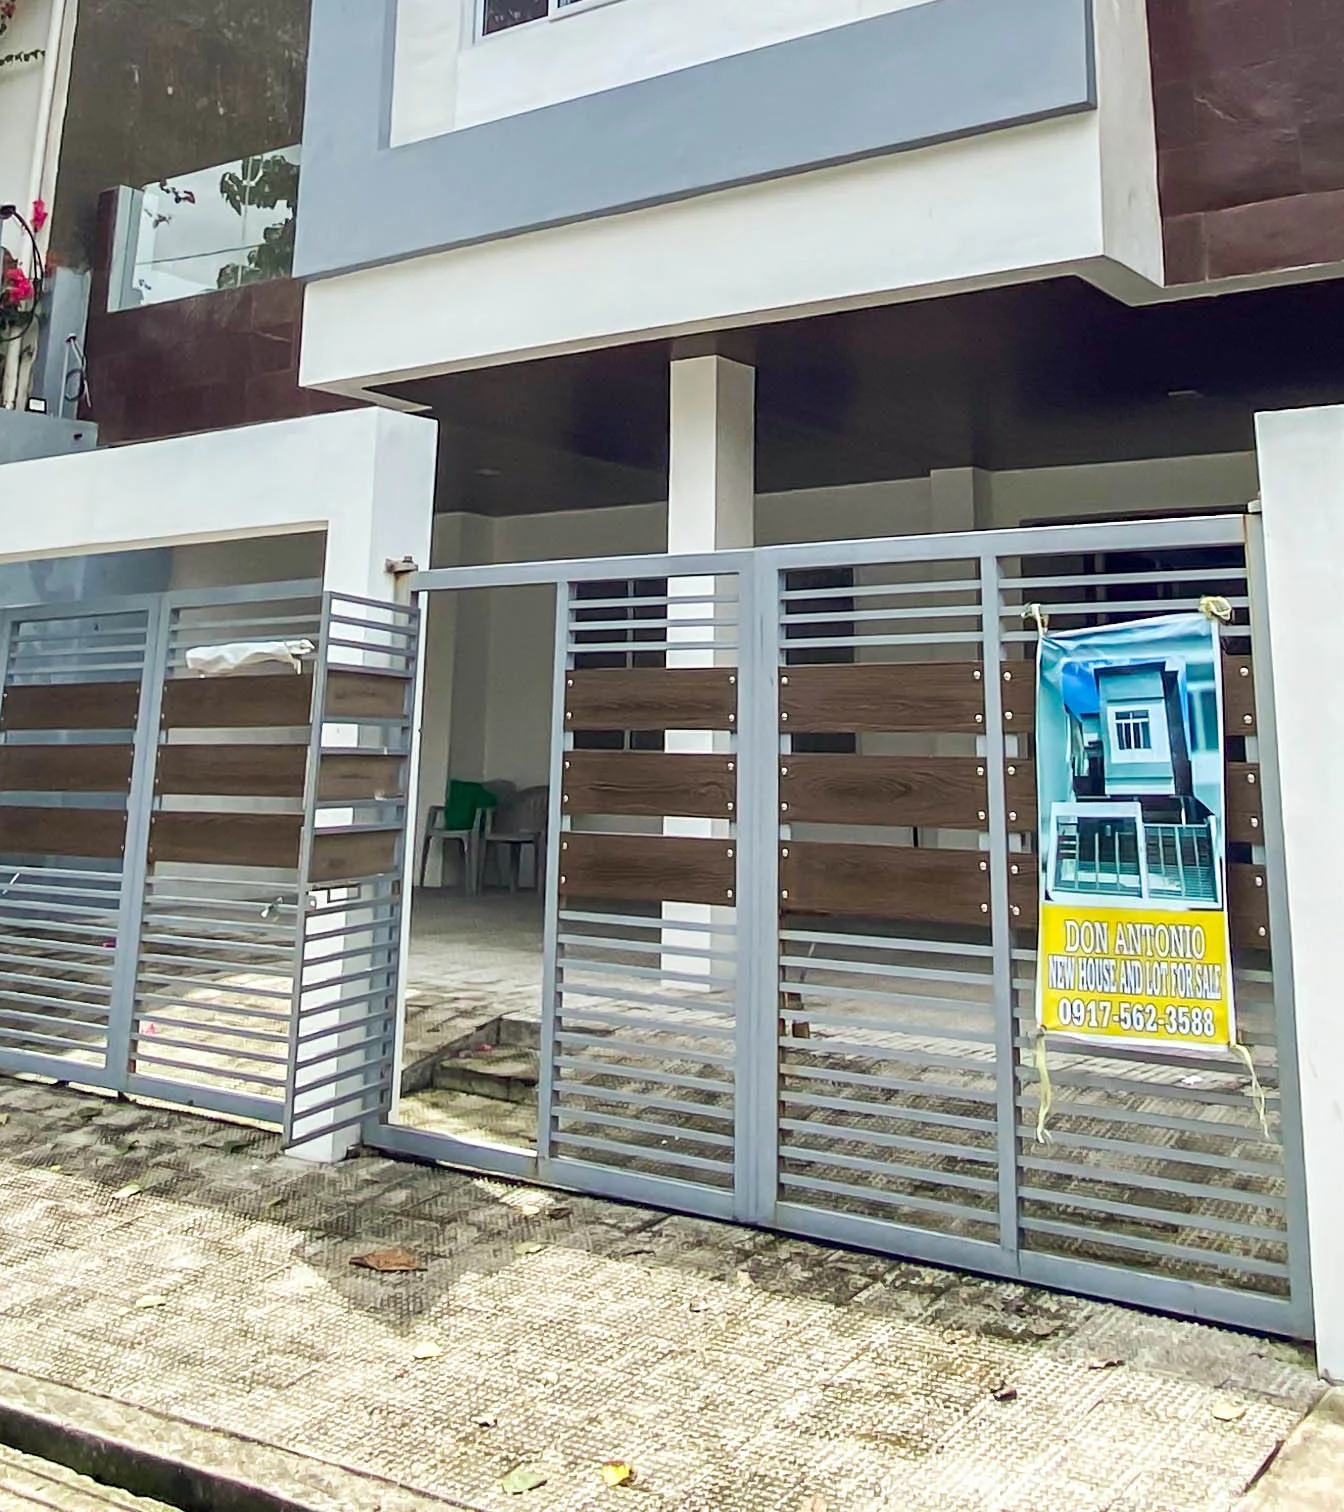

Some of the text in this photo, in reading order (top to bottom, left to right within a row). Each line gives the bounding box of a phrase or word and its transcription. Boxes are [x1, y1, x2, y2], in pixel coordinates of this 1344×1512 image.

[1064, 919, 1205, 959] DON ANTONIO
[1048, 954, 1222, 1000] NEW HOUSE AND LOT FOR SALE
[1058, 996, 1215, 1037] 0917-562-3588
